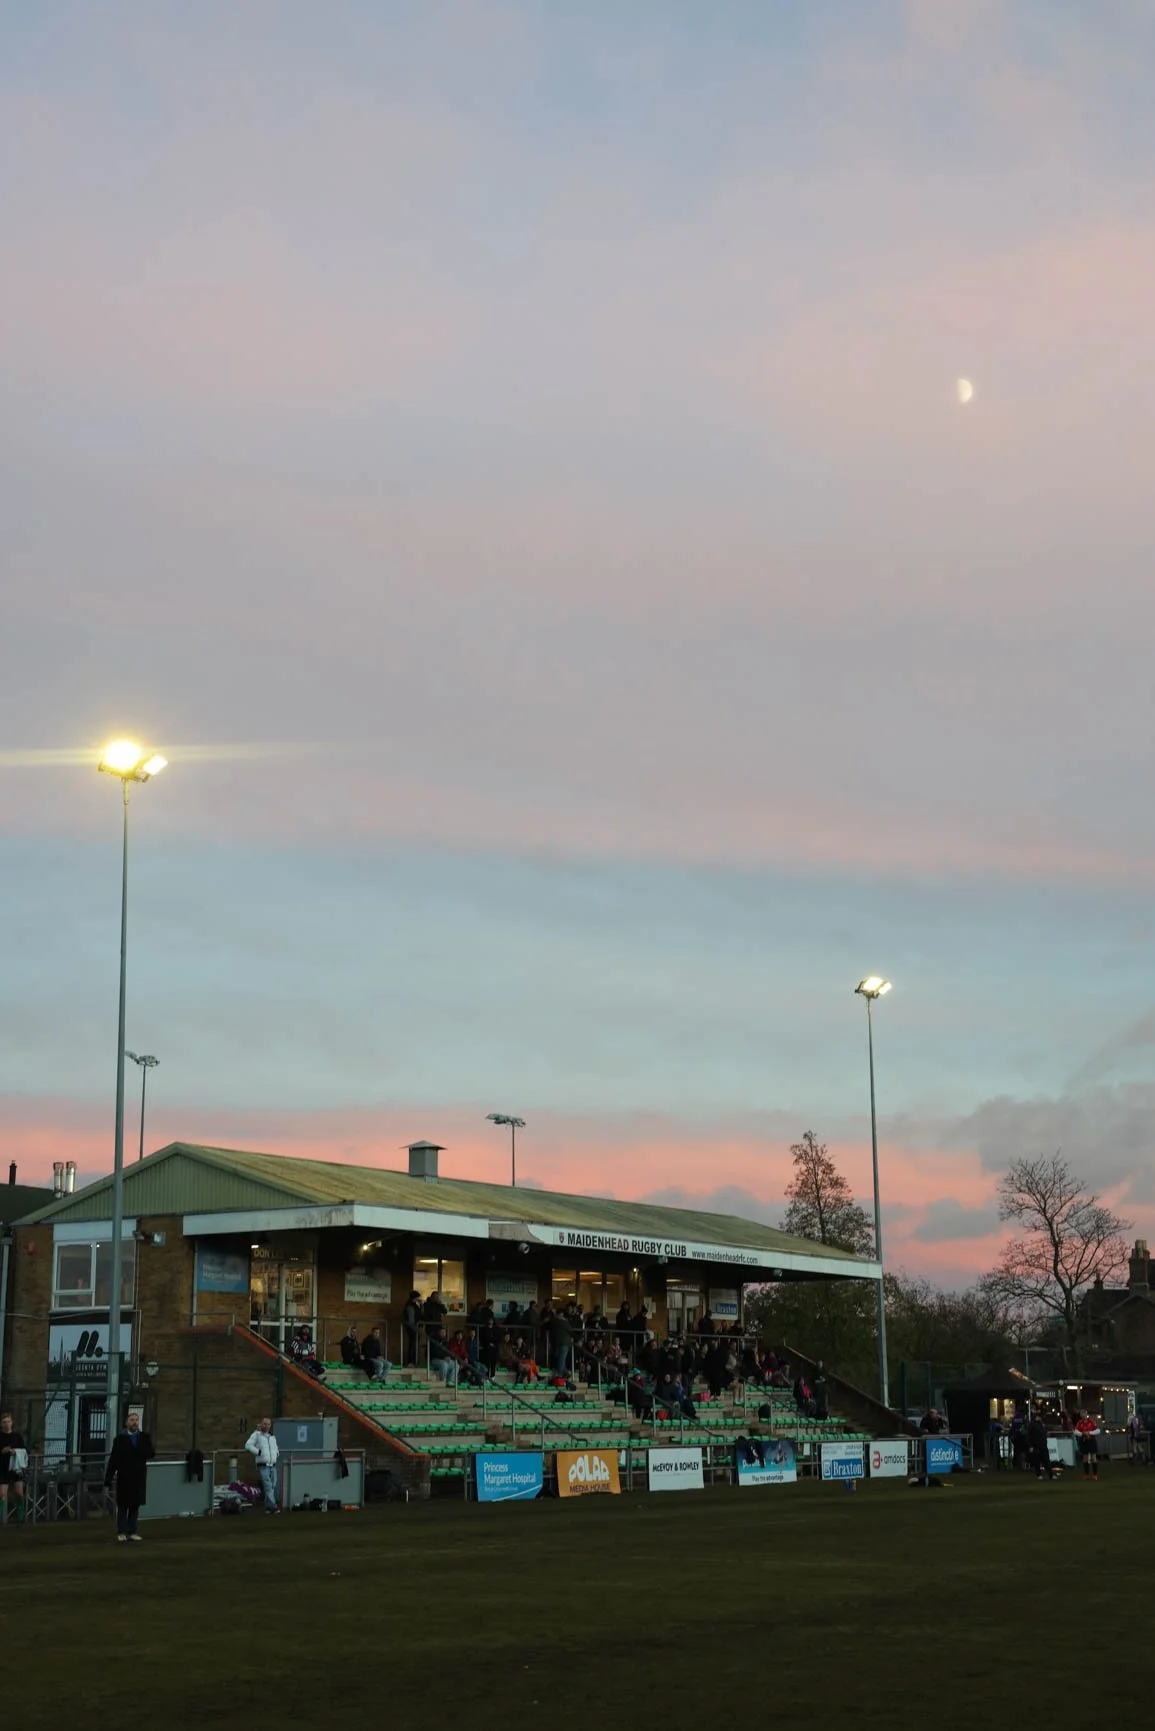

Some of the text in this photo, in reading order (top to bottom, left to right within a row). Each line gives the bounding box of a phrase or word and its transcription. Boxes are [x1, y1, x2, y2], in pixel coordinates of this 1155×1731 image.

[567, 1233, 687, 1257] MAIDENHEAD RUGBY CLUB
[692, 1249, 758, 1265] www.maidenheadrfc.com
[884, 1454, 906, 1465] amdocs
[483, 1462, 509, 1473] Princess
[568, 1454, 610, 1483] POLAR
[652, 1462, 699, 1473] McEVOY & ROWLEY
[833, 1461, 862, 1476] Braxton
[484, 1472, 536, 1486] Margaret Hospital
[570, 1485, 589, 1493] MEDIA
